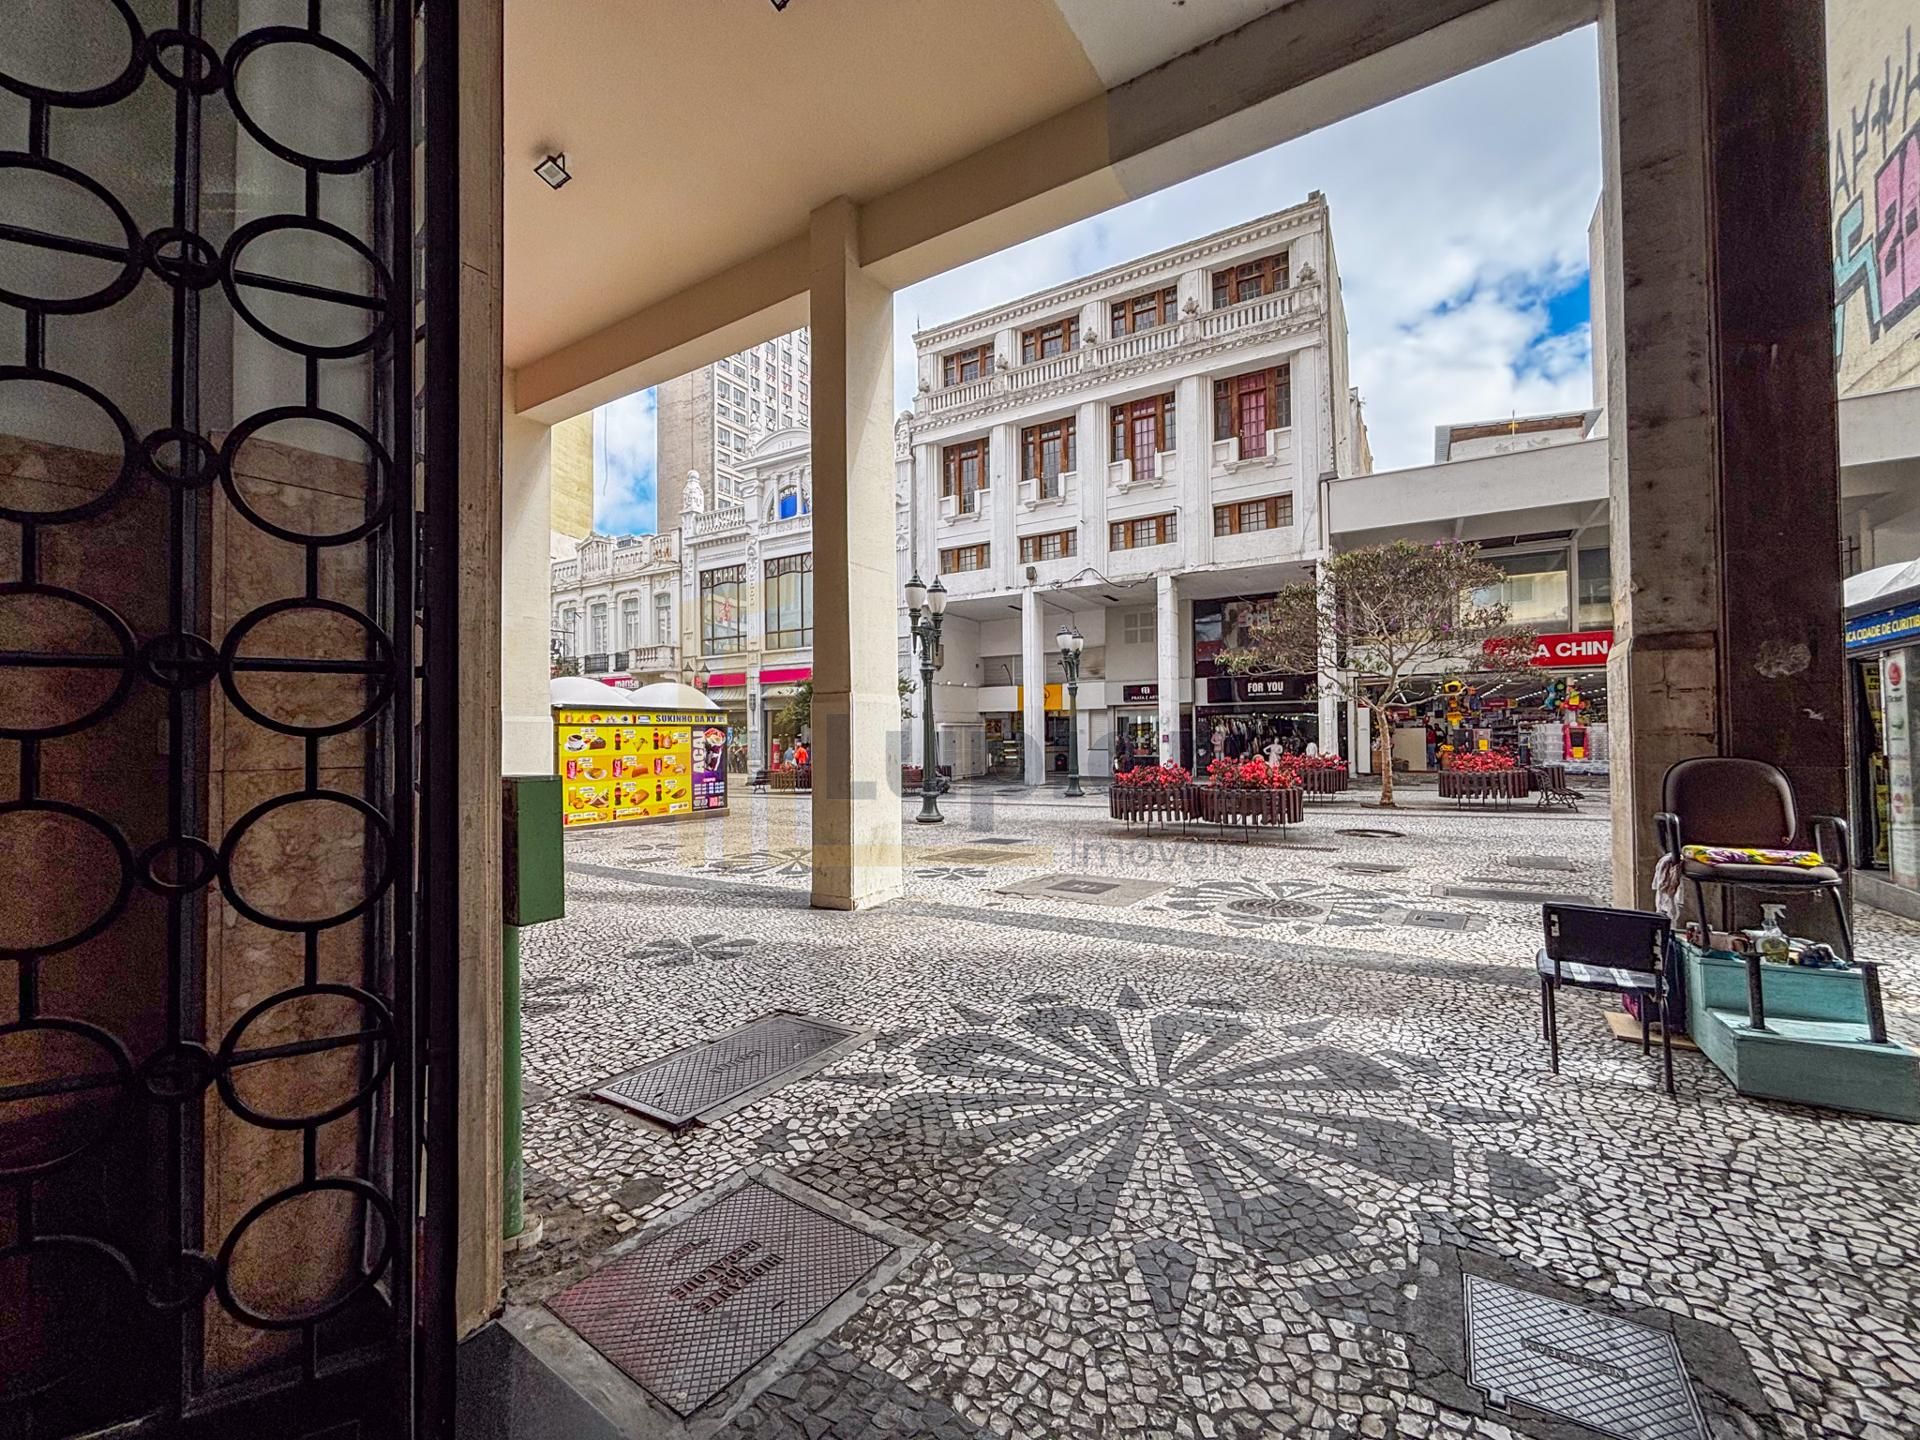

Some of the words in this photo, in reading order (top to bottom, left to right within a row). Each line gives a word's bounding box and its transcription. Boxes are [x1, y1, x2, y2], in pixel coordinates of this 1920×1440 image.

[1857, 624, 1881, 640] CIDADE
[1882, 622, 1891, 634] DE
[1892, 614, 1920, 632] CURITIB
[1555, 640, 1608, 657] CHIN
[1247, 682, 1264, 693] FOR
[1267, 681, 1284, 692] YOU
[655, 713, 693, 723] SUKINHO
[694, 714, 705, 723] DA
[706, 713, 716, 722] XV
[694, 1252, 784, 1314] HIDRANTE
